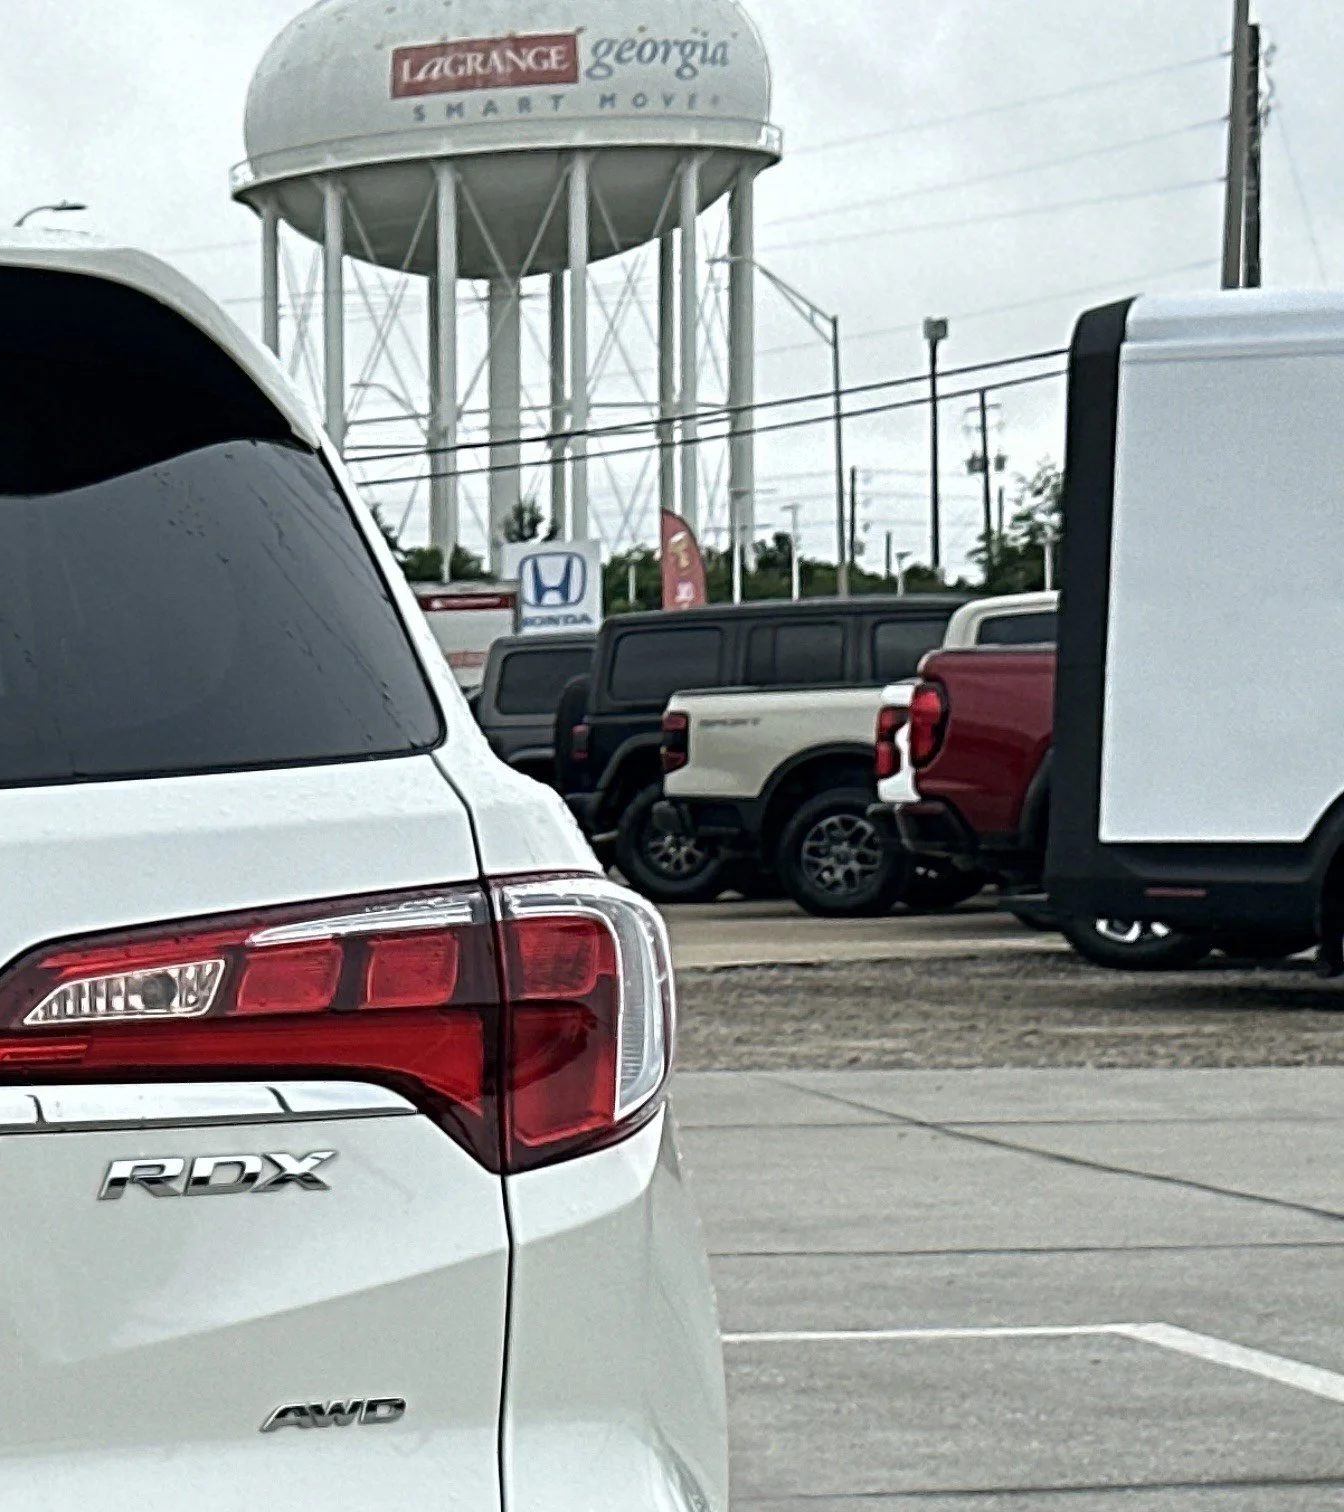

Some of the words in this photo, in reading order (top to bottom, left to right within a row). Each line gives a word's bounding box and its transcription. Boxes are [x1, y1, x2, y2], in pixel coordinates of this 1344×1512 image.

[585, 36, 730, 80] georgia
[413, 94, 565, 122] SMART
[522, 613, 593, 628] HONDA
[96, 1150, 339, 1201] RDX
[259, 1397, 407, 1433] AWD
